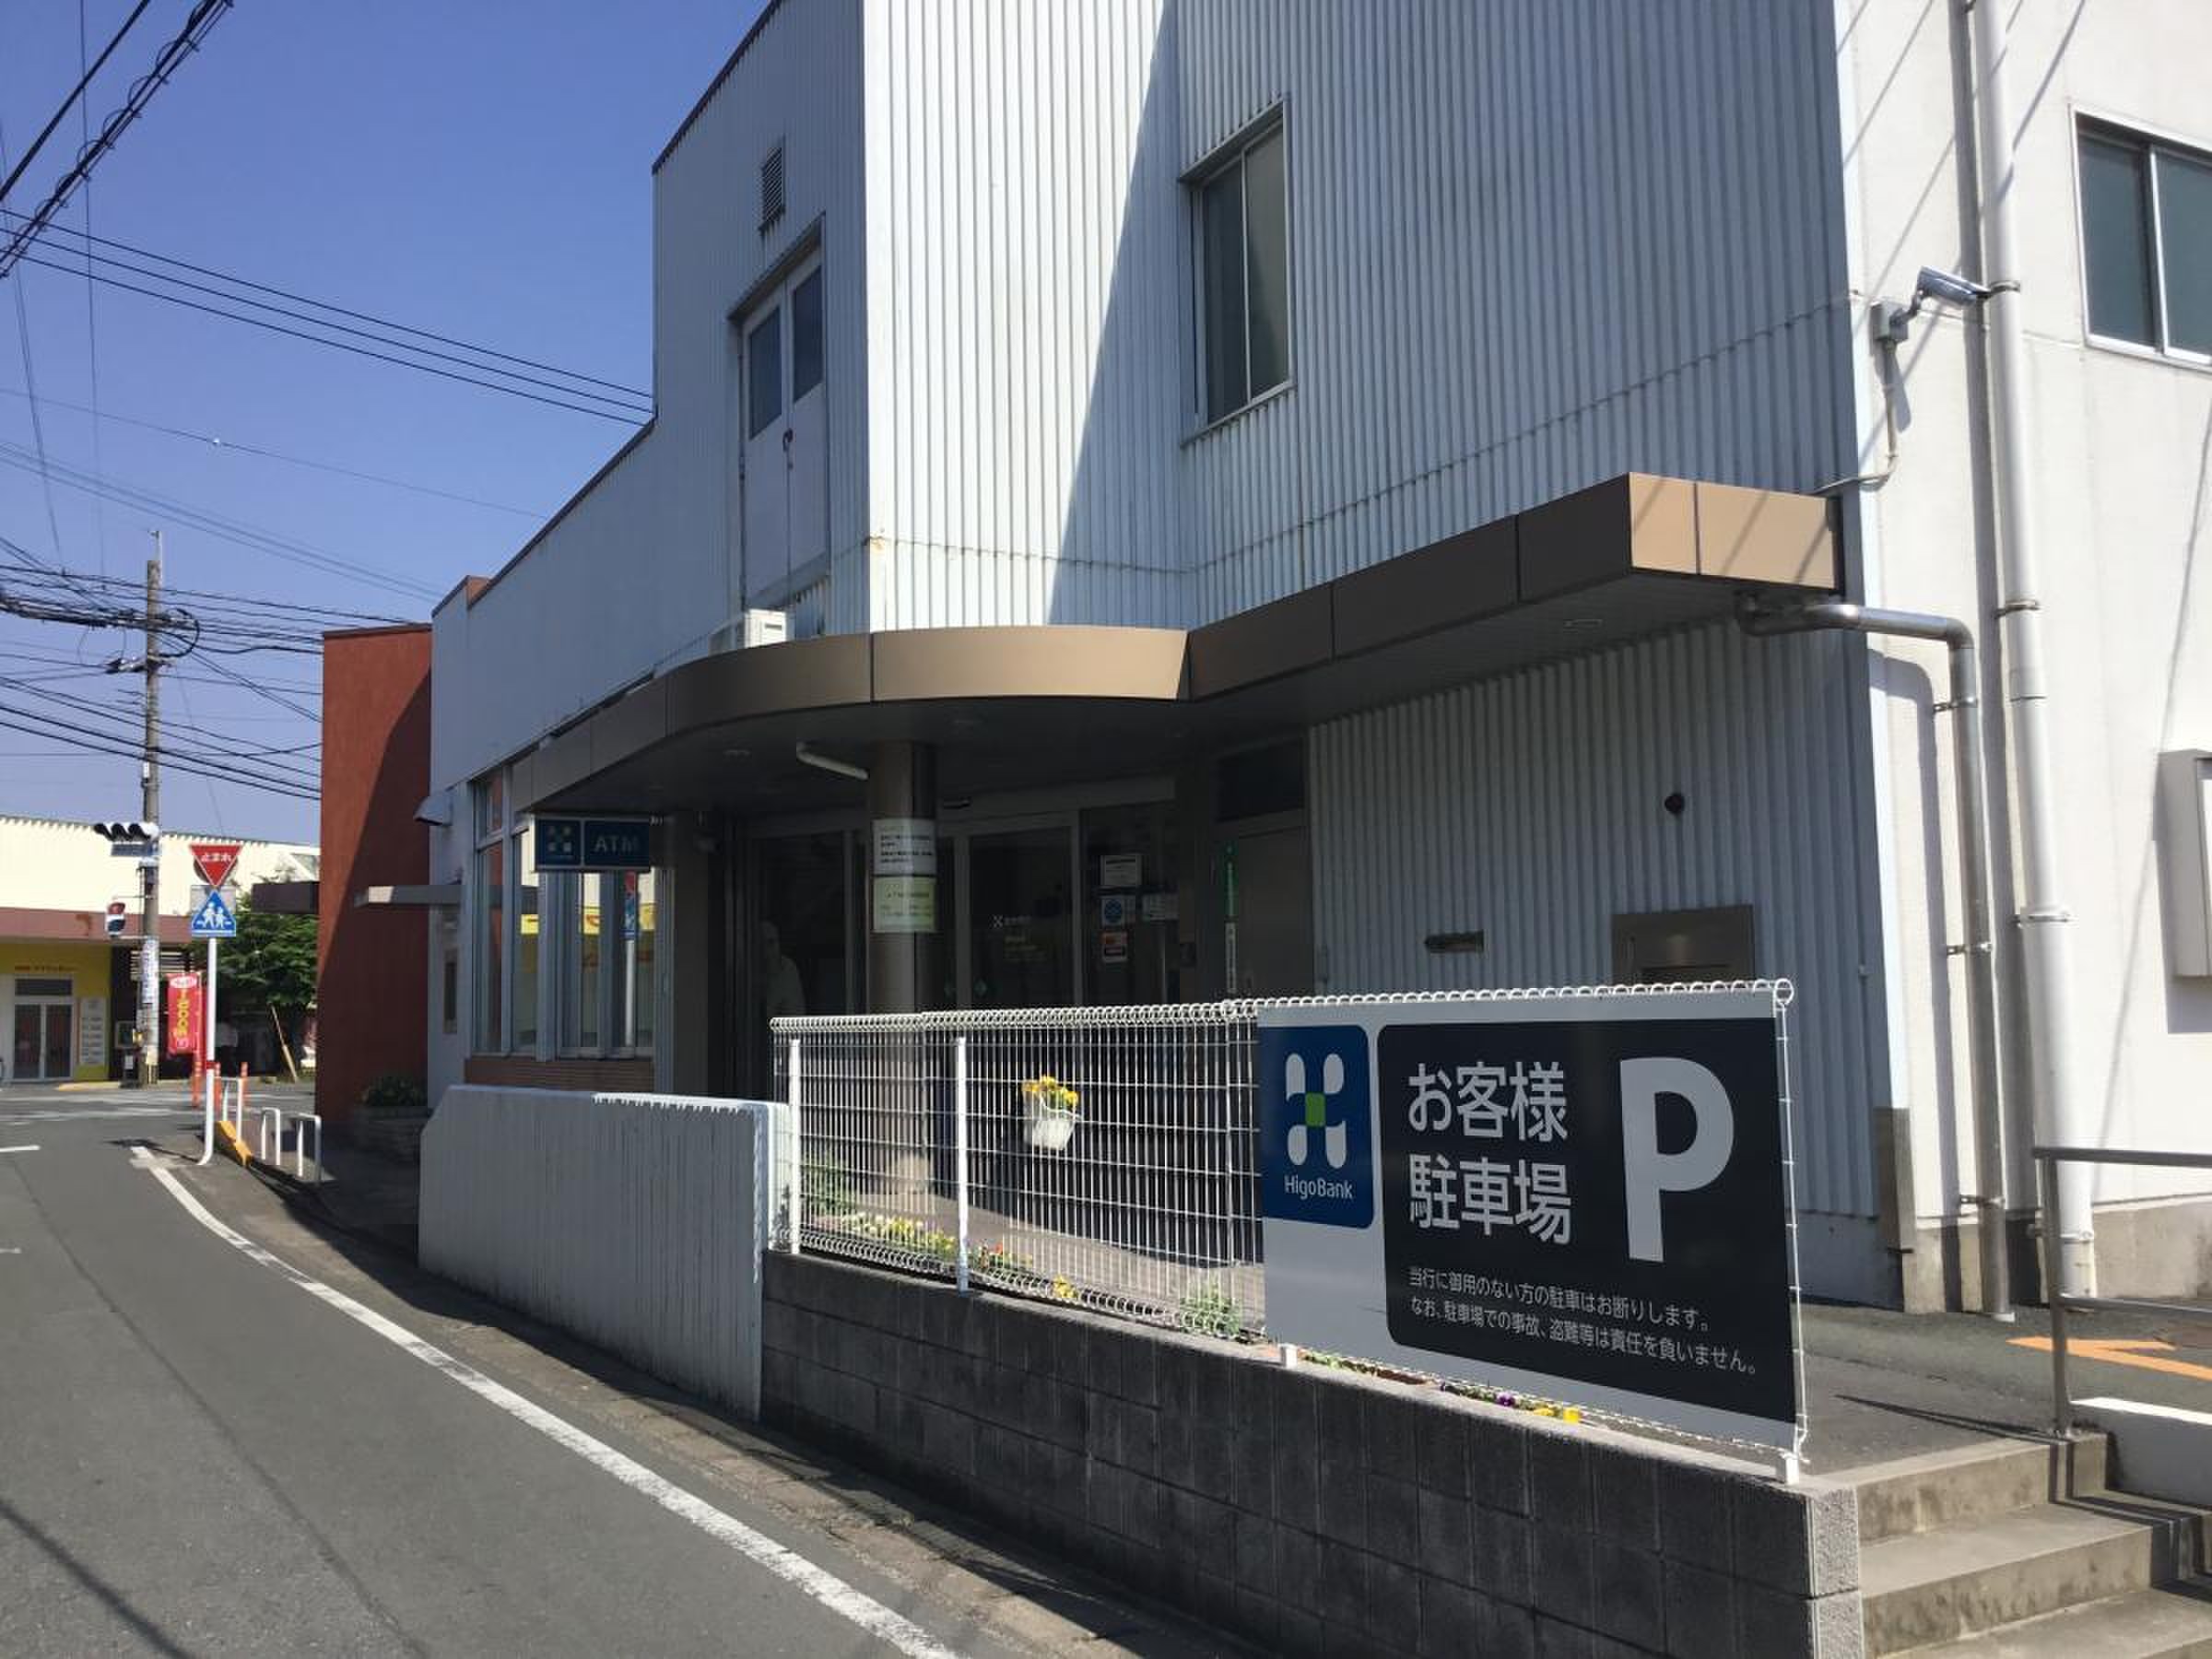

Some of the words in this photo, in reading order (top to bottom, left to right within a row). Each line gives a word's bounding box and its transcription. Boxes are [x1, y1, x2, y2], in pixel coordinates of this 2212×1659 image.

[594, 834, 641, 853] ATM
[1407, 1061, 1568, 1143] お客様
[1284, 1175, 1354, 1201] HigoBank
[1409, 1153, 1571, 1245] 駐車場
[1619, 1057, 1735, 1263] P
[1408, 1266, 1710, 1333] 当行に御用のない方の駐車はお断りします。
[1411, 1295, 1757, 1375] なお、駐車場での事故、盗難等は責任を負いません。
